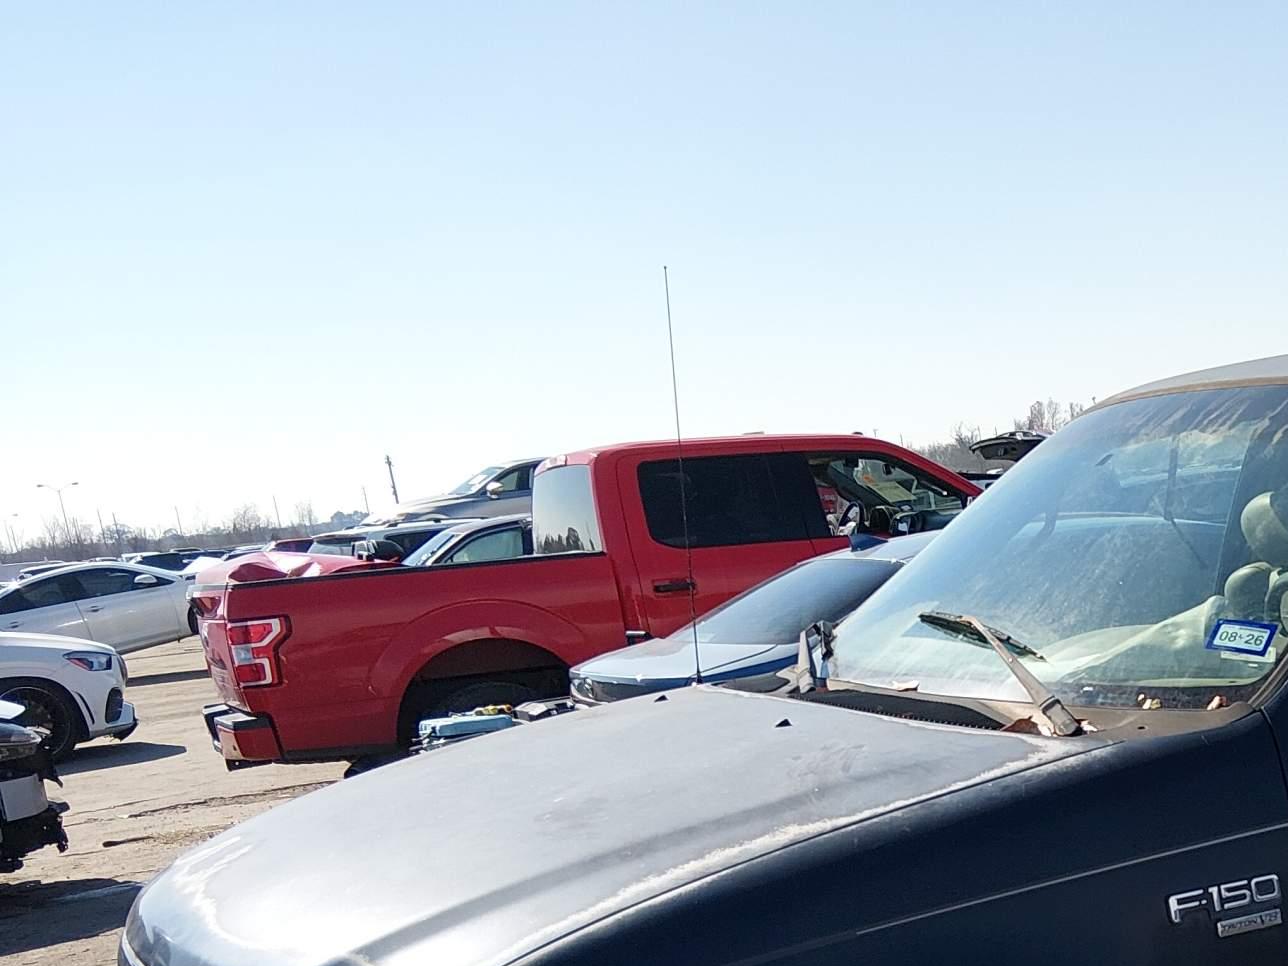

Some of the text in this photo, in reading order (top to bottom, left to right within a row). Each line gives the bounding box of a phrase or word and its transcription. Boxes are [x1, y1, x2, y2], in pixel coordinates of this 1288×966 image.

[1218, 630, 1265, 646] 08 26
[1168, 874, 1280, 923] F-150
